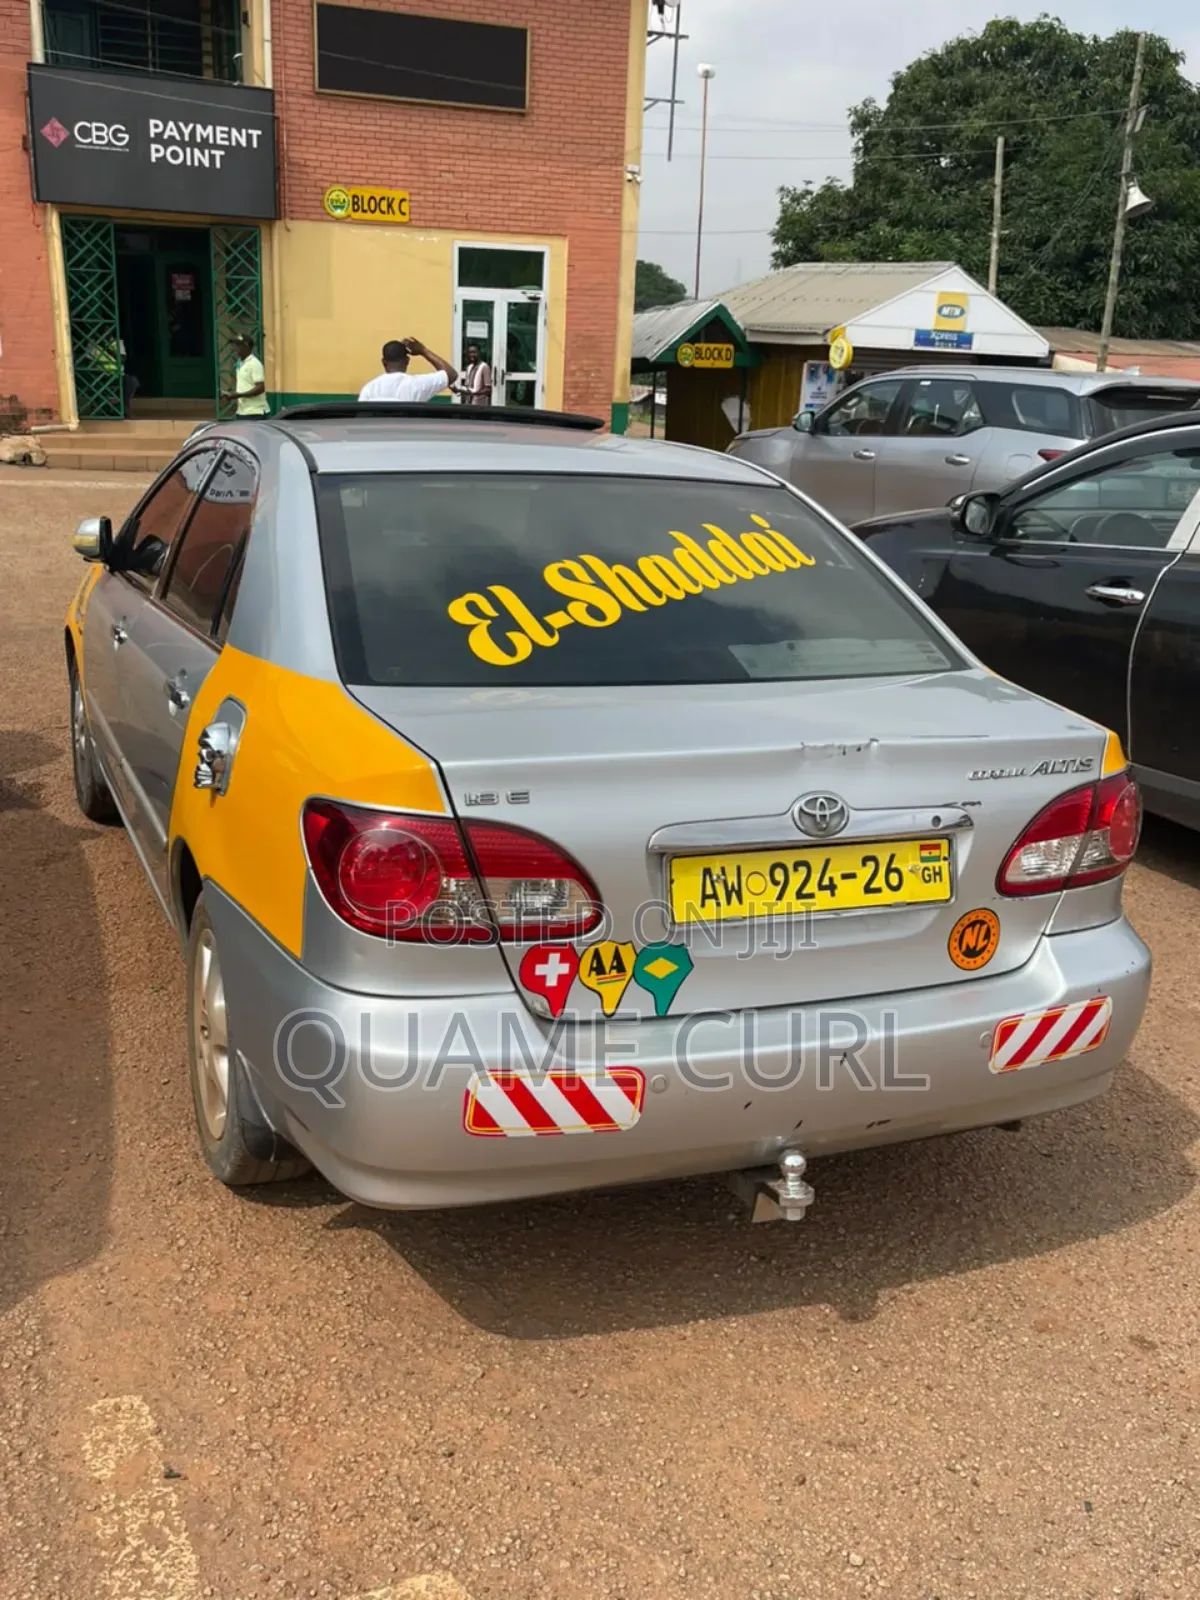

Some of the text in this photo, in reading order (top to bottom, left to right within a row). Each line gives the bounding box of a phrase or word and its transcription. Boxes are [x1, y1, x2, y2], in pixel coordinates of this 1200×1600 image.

[74, 121, 130, 146] CBG
[149, 118, 262, 149] PAYMENT
[150, 143, 225, 169] POINT
[351, 194, 407, 216] BLOCK C
[694, 346, 732, 361] BLOCK D
[447, 512, 816, 667] El-Shaddai
[1027, 757, 1095, 777] ALTIS
[505, 788, 531, 805] E
[700, 852, 905, 908] AW 924-26
[920, 865, 943, 884] GH
[588, 945, 628, 978] AA
